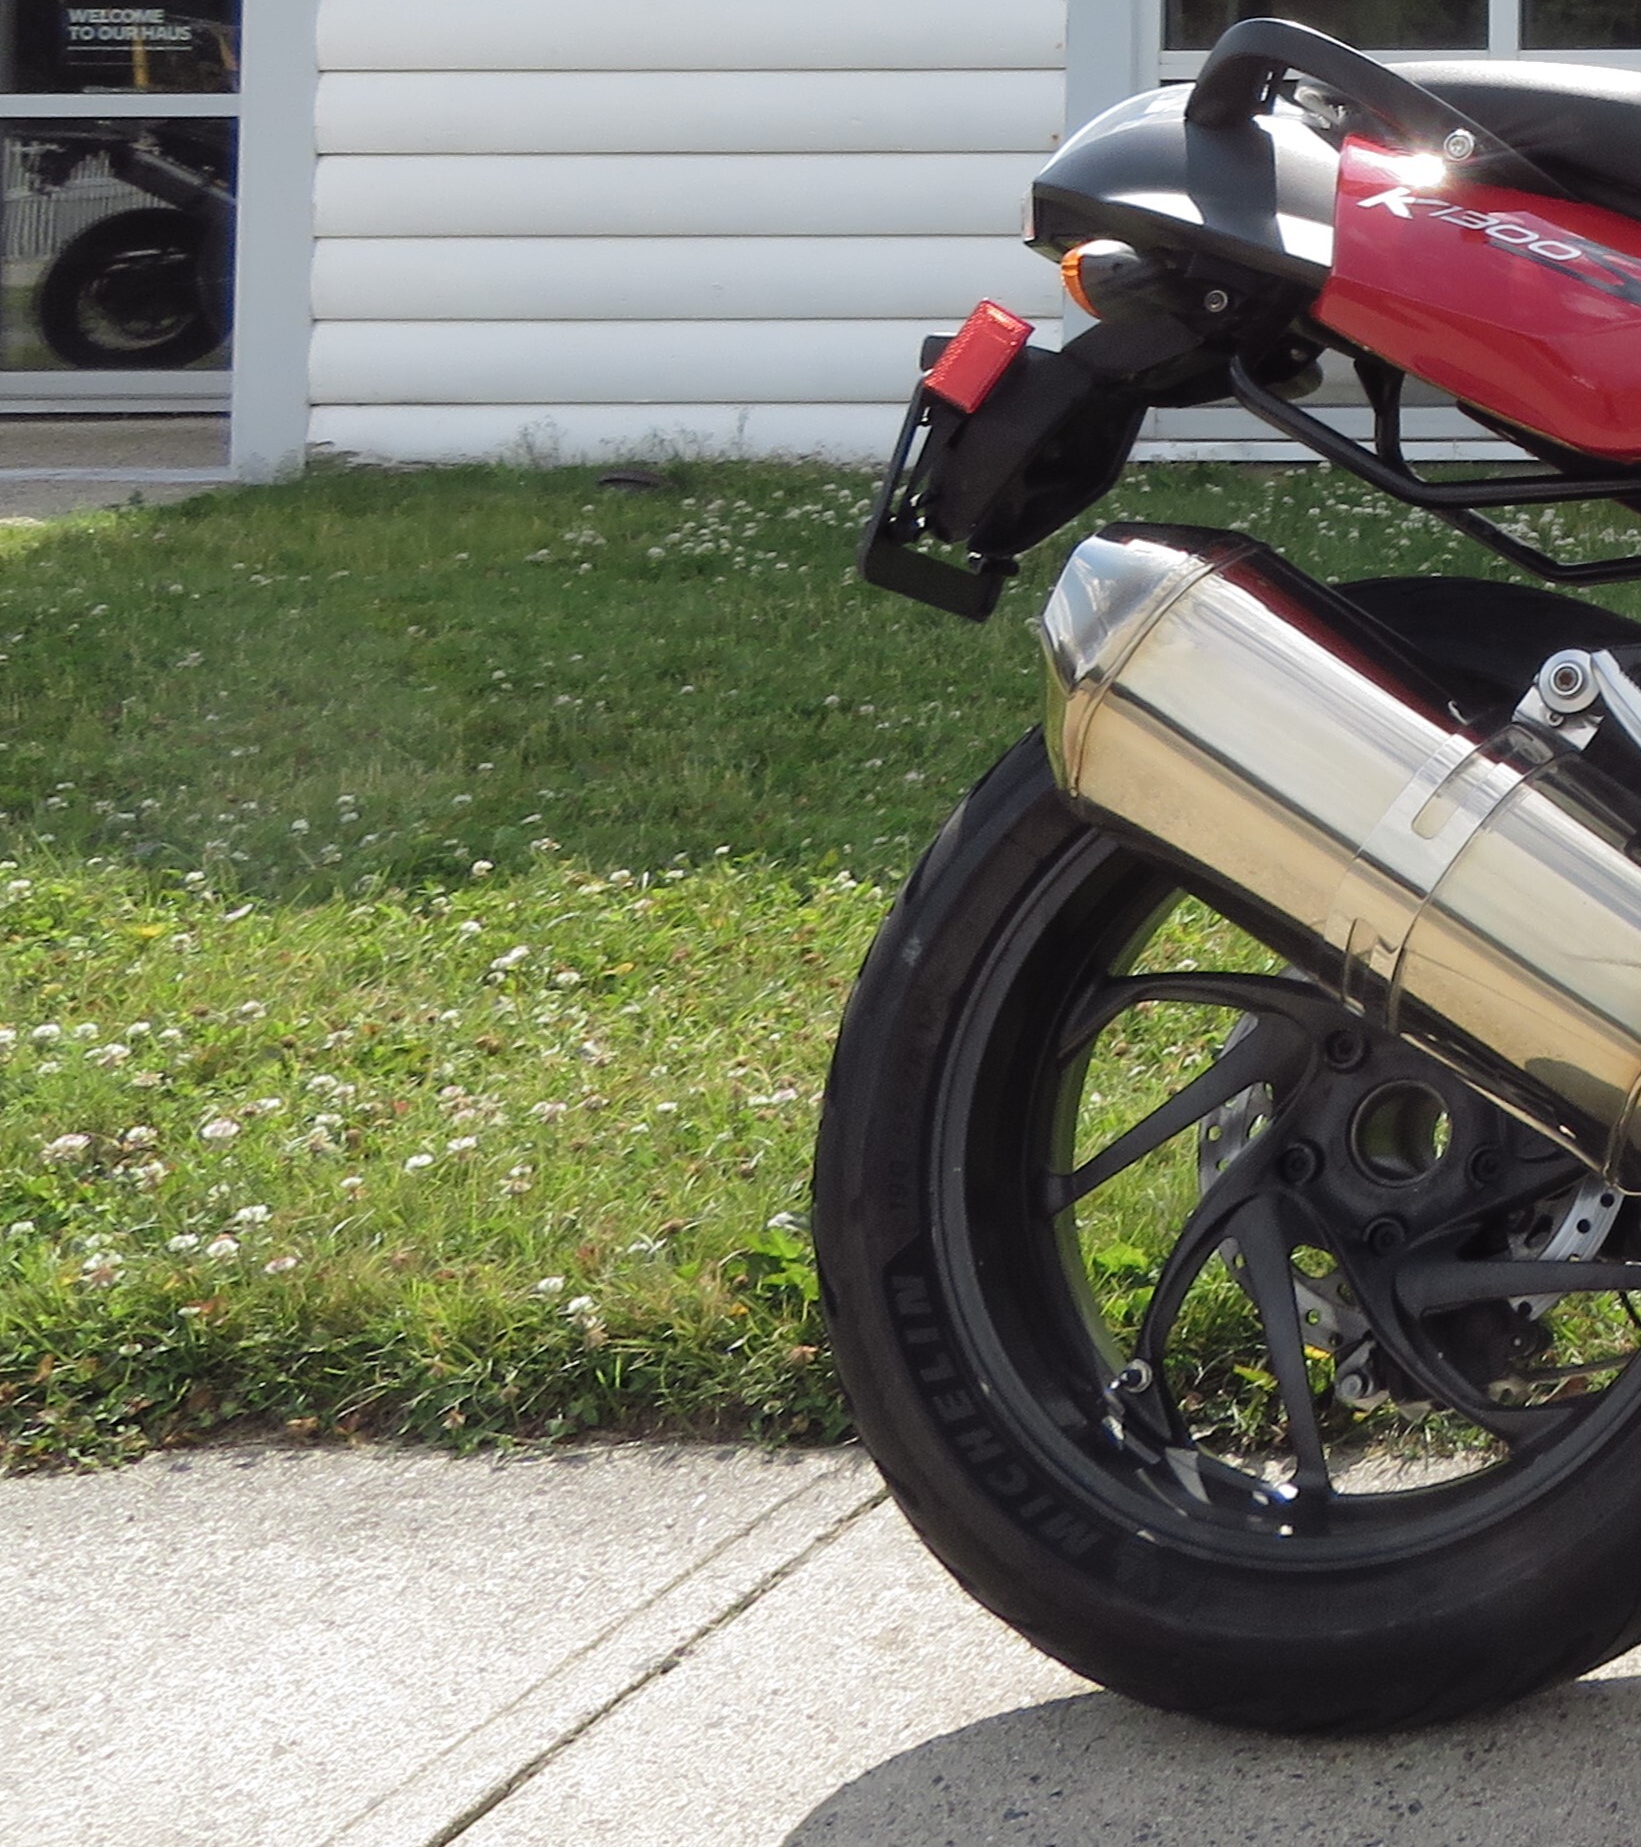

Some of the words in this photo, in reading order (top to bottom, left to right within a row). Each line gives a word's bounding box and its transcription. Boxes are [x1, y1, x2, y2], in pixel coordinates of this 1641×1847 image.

[68, 8, 165, 23] WELCOME
[68, 26, 95, 40] TO
[98, 26, 138, 40] OUR
[140, 26, 192, 40] HAUS
[891, 1274, 1100, 1554] MICHELIN
